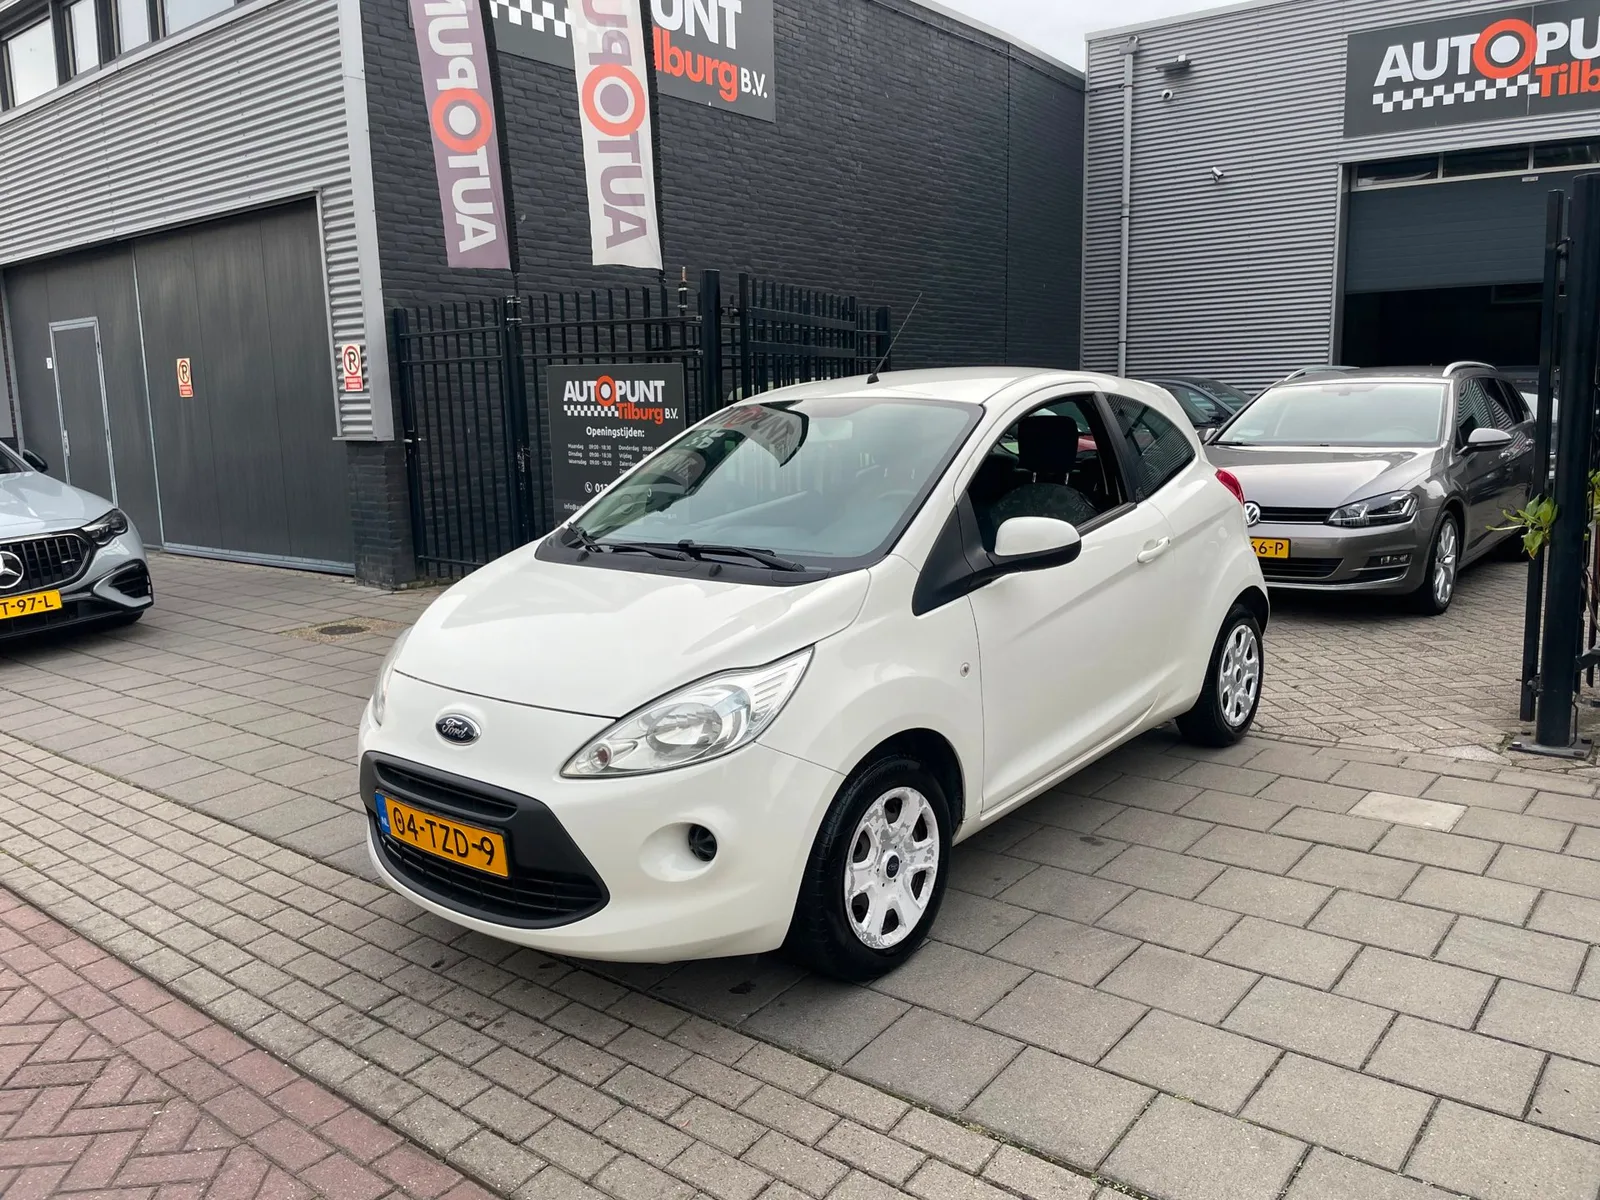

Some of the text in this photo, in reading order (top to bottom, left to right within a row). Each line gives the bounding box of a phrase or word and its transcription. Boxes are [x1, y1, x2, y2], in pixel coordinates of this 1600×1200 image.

[740, 66, 768, 99] B.V.
[563, 375, 665, 407] AUTOPUNT
[616, 402, 679, 425] Tilburg B.V.
[585, 426, 645, 438] Openingstijden:
[393, 806, 496, 867] 04-TZD-9
